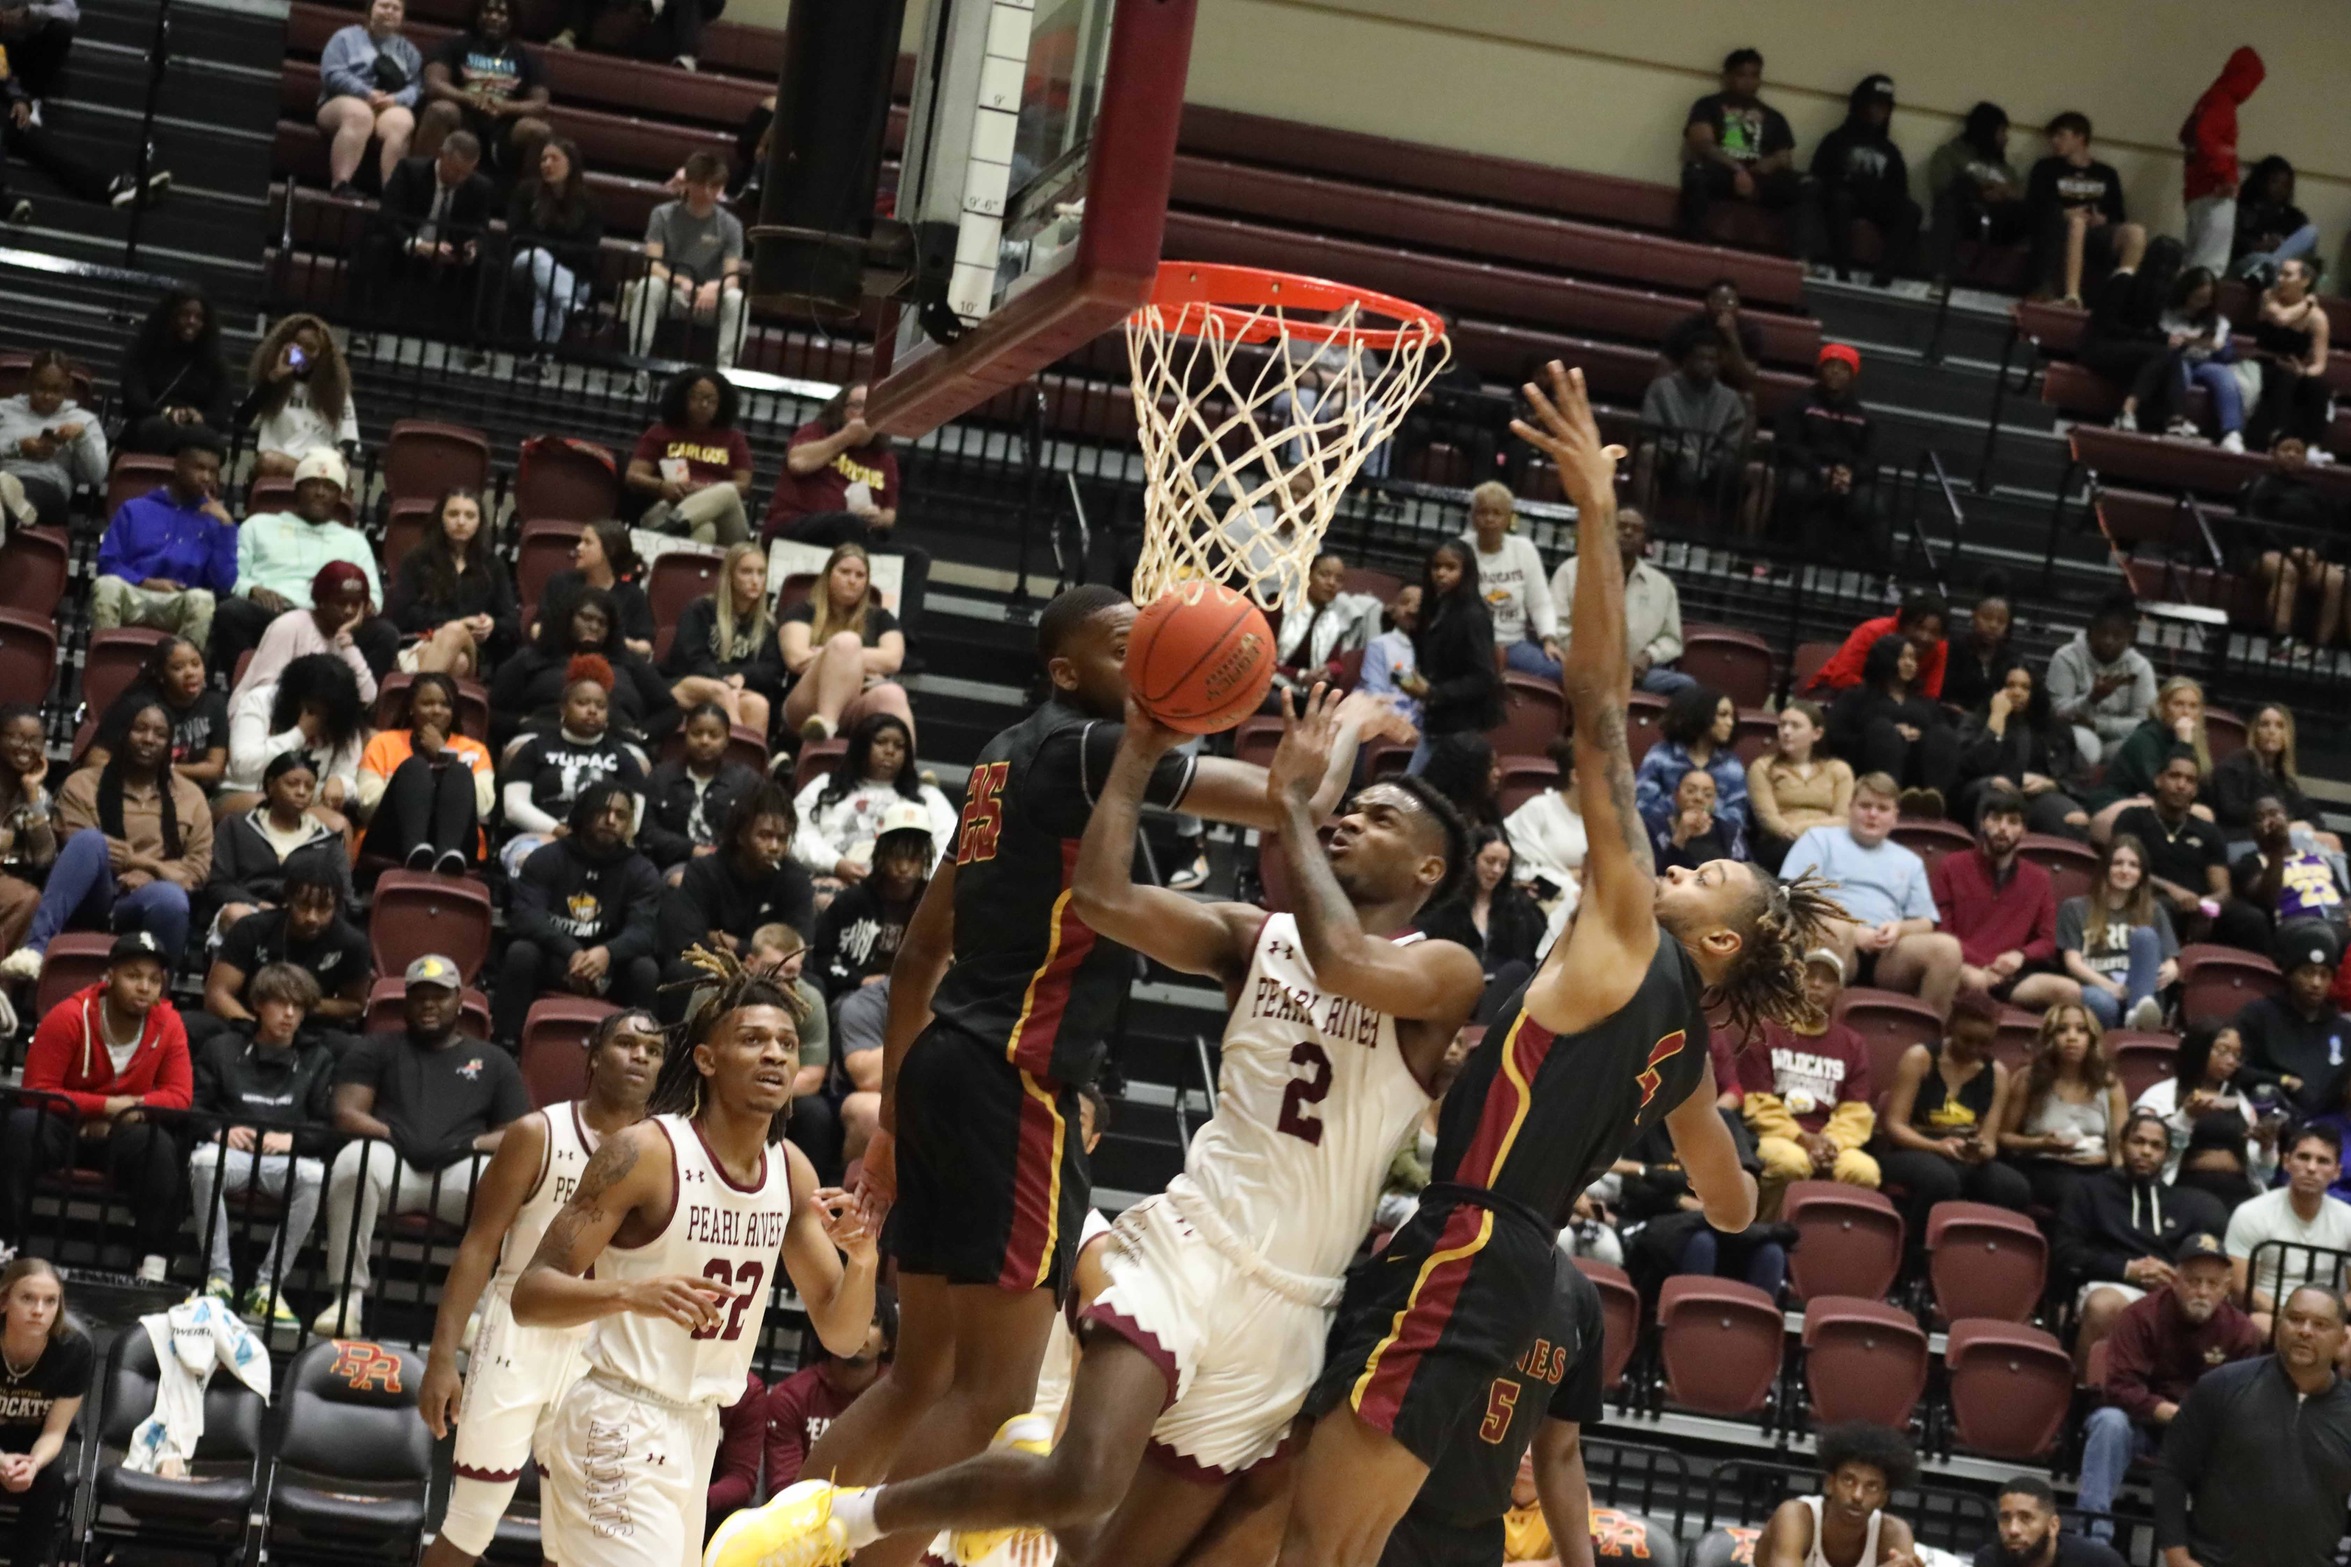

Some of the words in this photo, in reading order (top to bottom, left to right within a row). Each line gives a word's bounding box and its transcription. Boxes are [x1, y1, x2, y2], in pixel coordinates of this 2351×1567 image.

[545, 750, 619, 772] TUPAC
[956, 761, 1010, 867] 25
[1252, 977, 1321, 1027] PEARL
[1277, 1041, 1334, 1147] 2
[687, 1205, 741, 1246] PEARL
[690, 1257, 765, 1341] 22
[1479, 1377, 1522, 1445] 5
